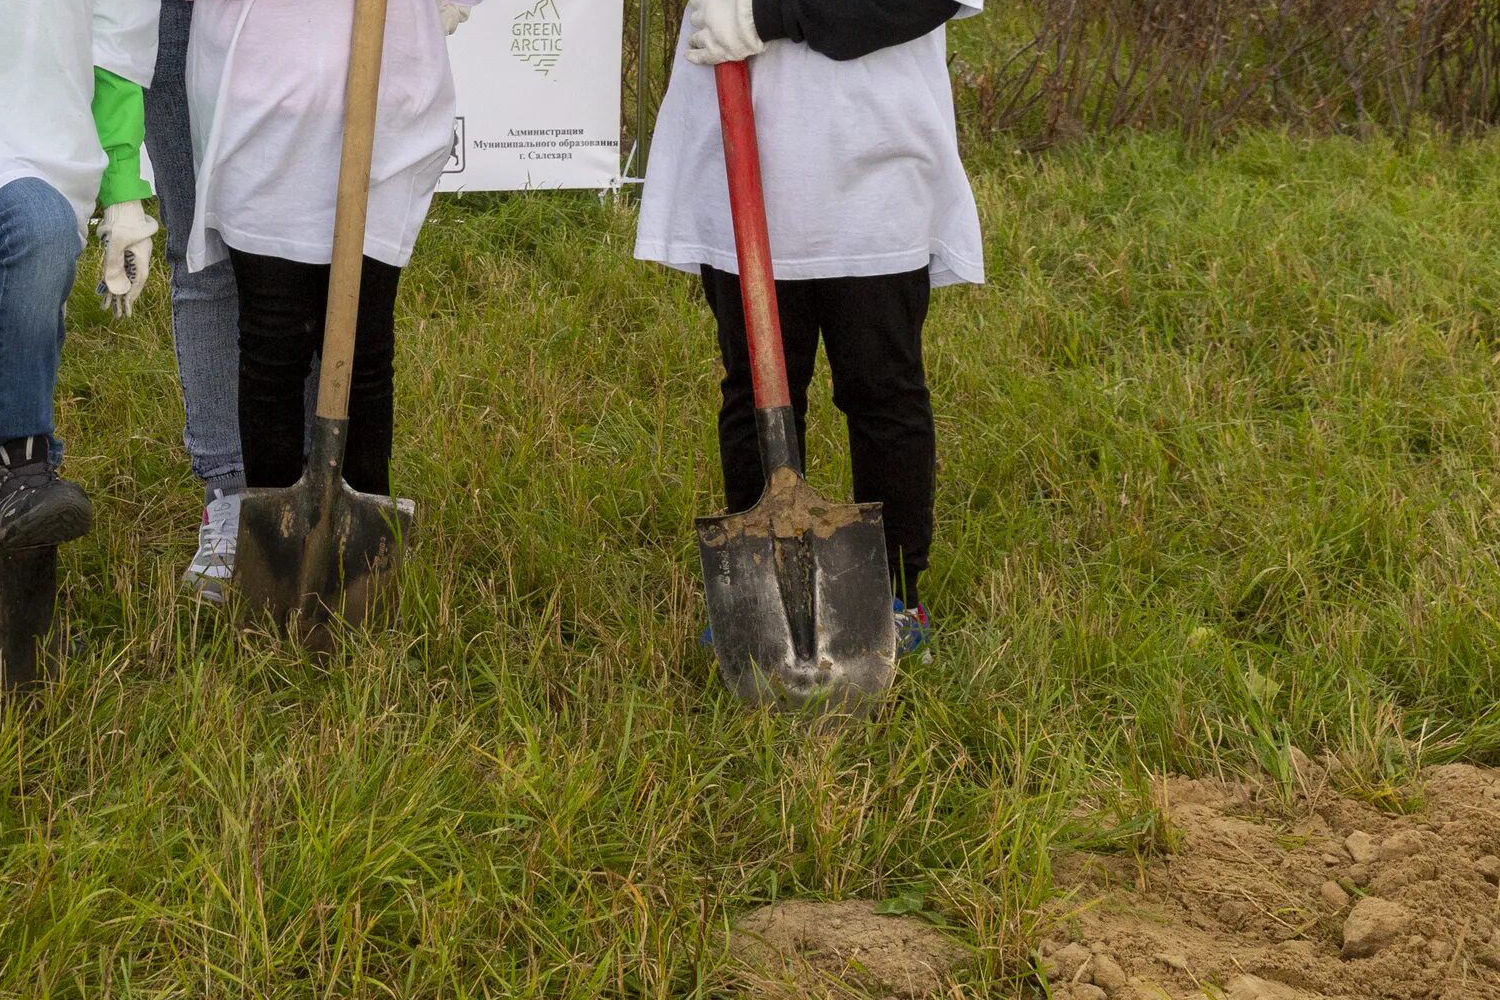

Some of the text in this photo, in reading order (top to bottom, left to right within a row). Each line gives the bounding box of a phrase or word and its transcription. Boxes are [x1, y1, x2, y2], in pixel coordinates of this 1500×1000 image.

[511, 22, 562, 37] GREEN
[510, 38, 564, 52] ARCTIC
[507, 128, 584, 137] Администрация
[473, 139, 619, 150] Муниципального образования
[519, 150, 573, 161] г. Салехард
